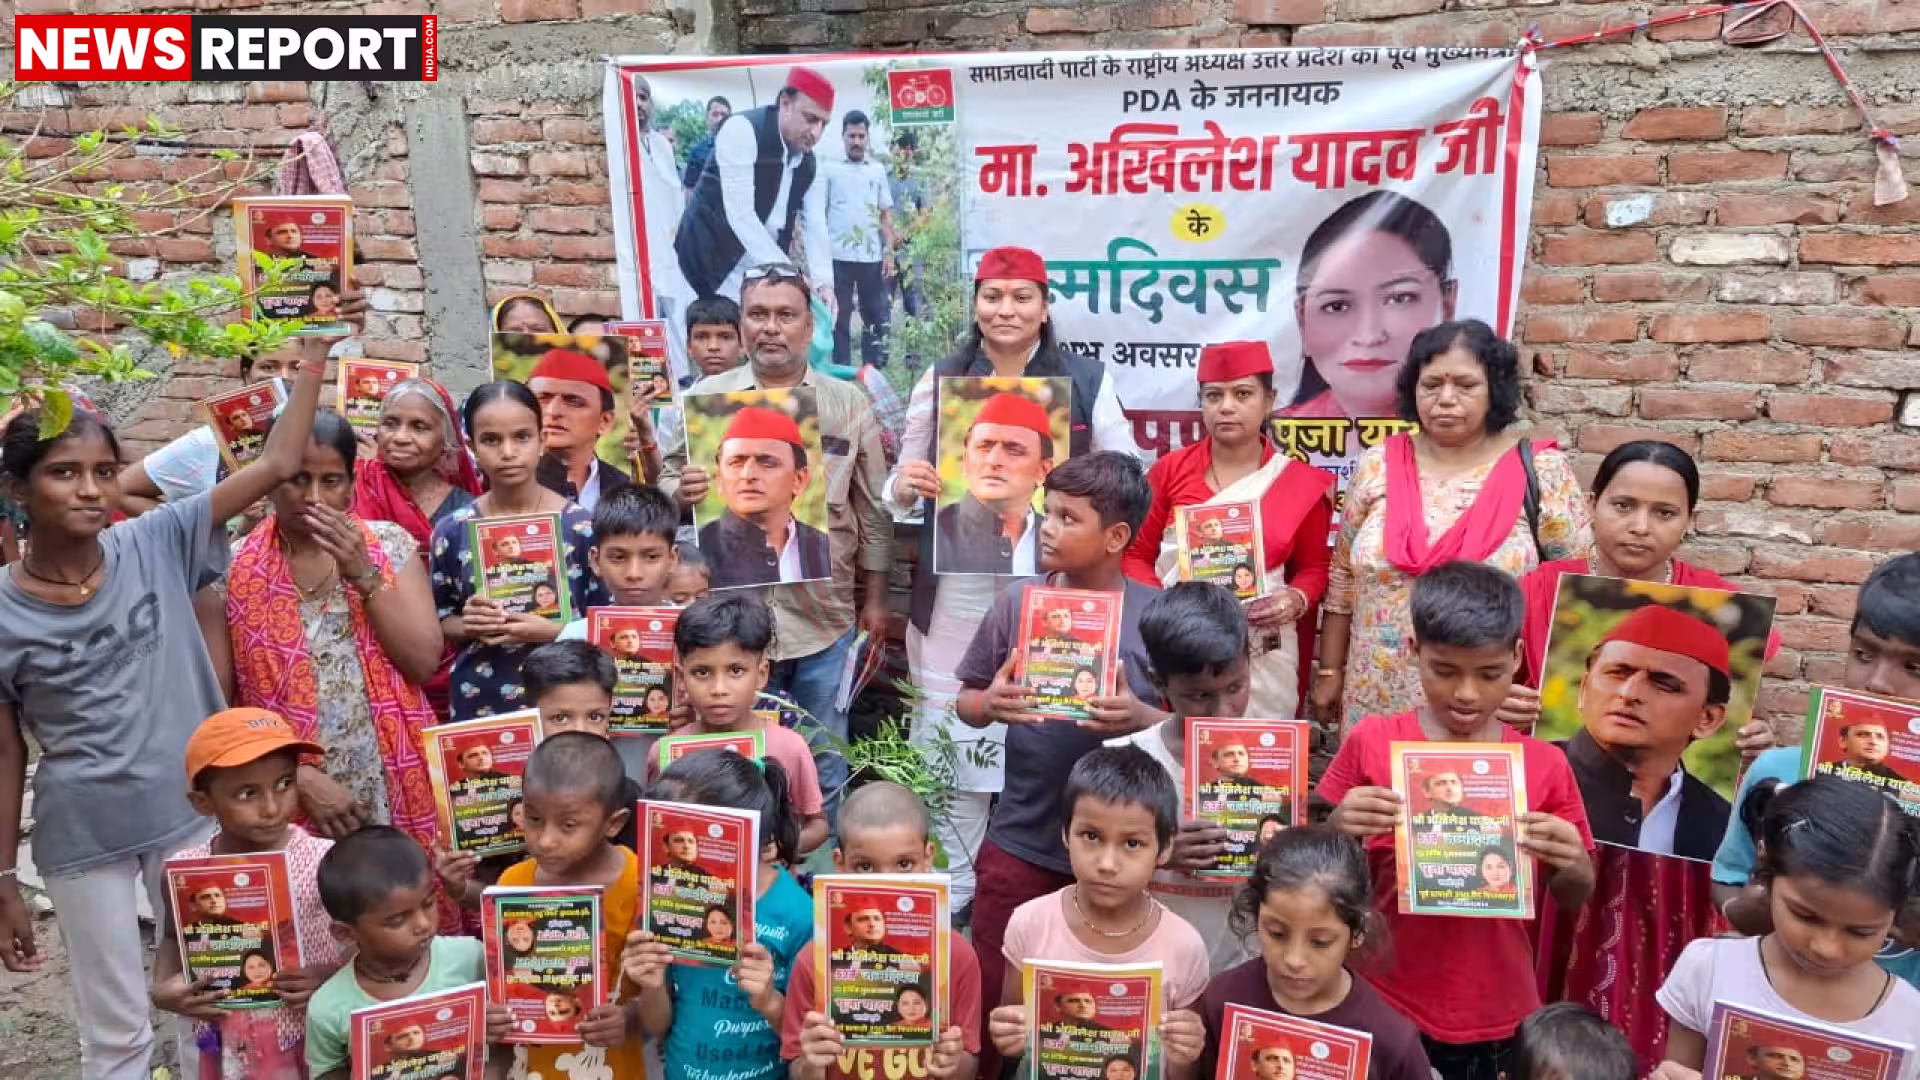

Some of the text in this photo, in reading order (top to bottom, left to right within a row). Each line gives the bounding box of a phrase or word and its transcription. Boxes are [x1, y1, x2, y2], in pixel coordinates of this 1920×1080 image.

[969, 58, 1054, 83] समाजवादी
[1059, 55, 1098, 78] पार्टी
[1102, 54, 1122, 77] के
[1127, 53, 1179, 79] राष्ट्रीय
[1184, 53, 1245, 73] अध्यक्ष
[1251, 52, 1289, 70] उत्तर
[1123, 79, 1343, 112] PDA के जननायक
[975, 97, 1505, 197] मा. अखिलेश यादव जी
[1186, 209, 1211, 237] के
[1112, 342, 1202, 368] अवसर
[1271, 417, 1353, 463] पूजा
